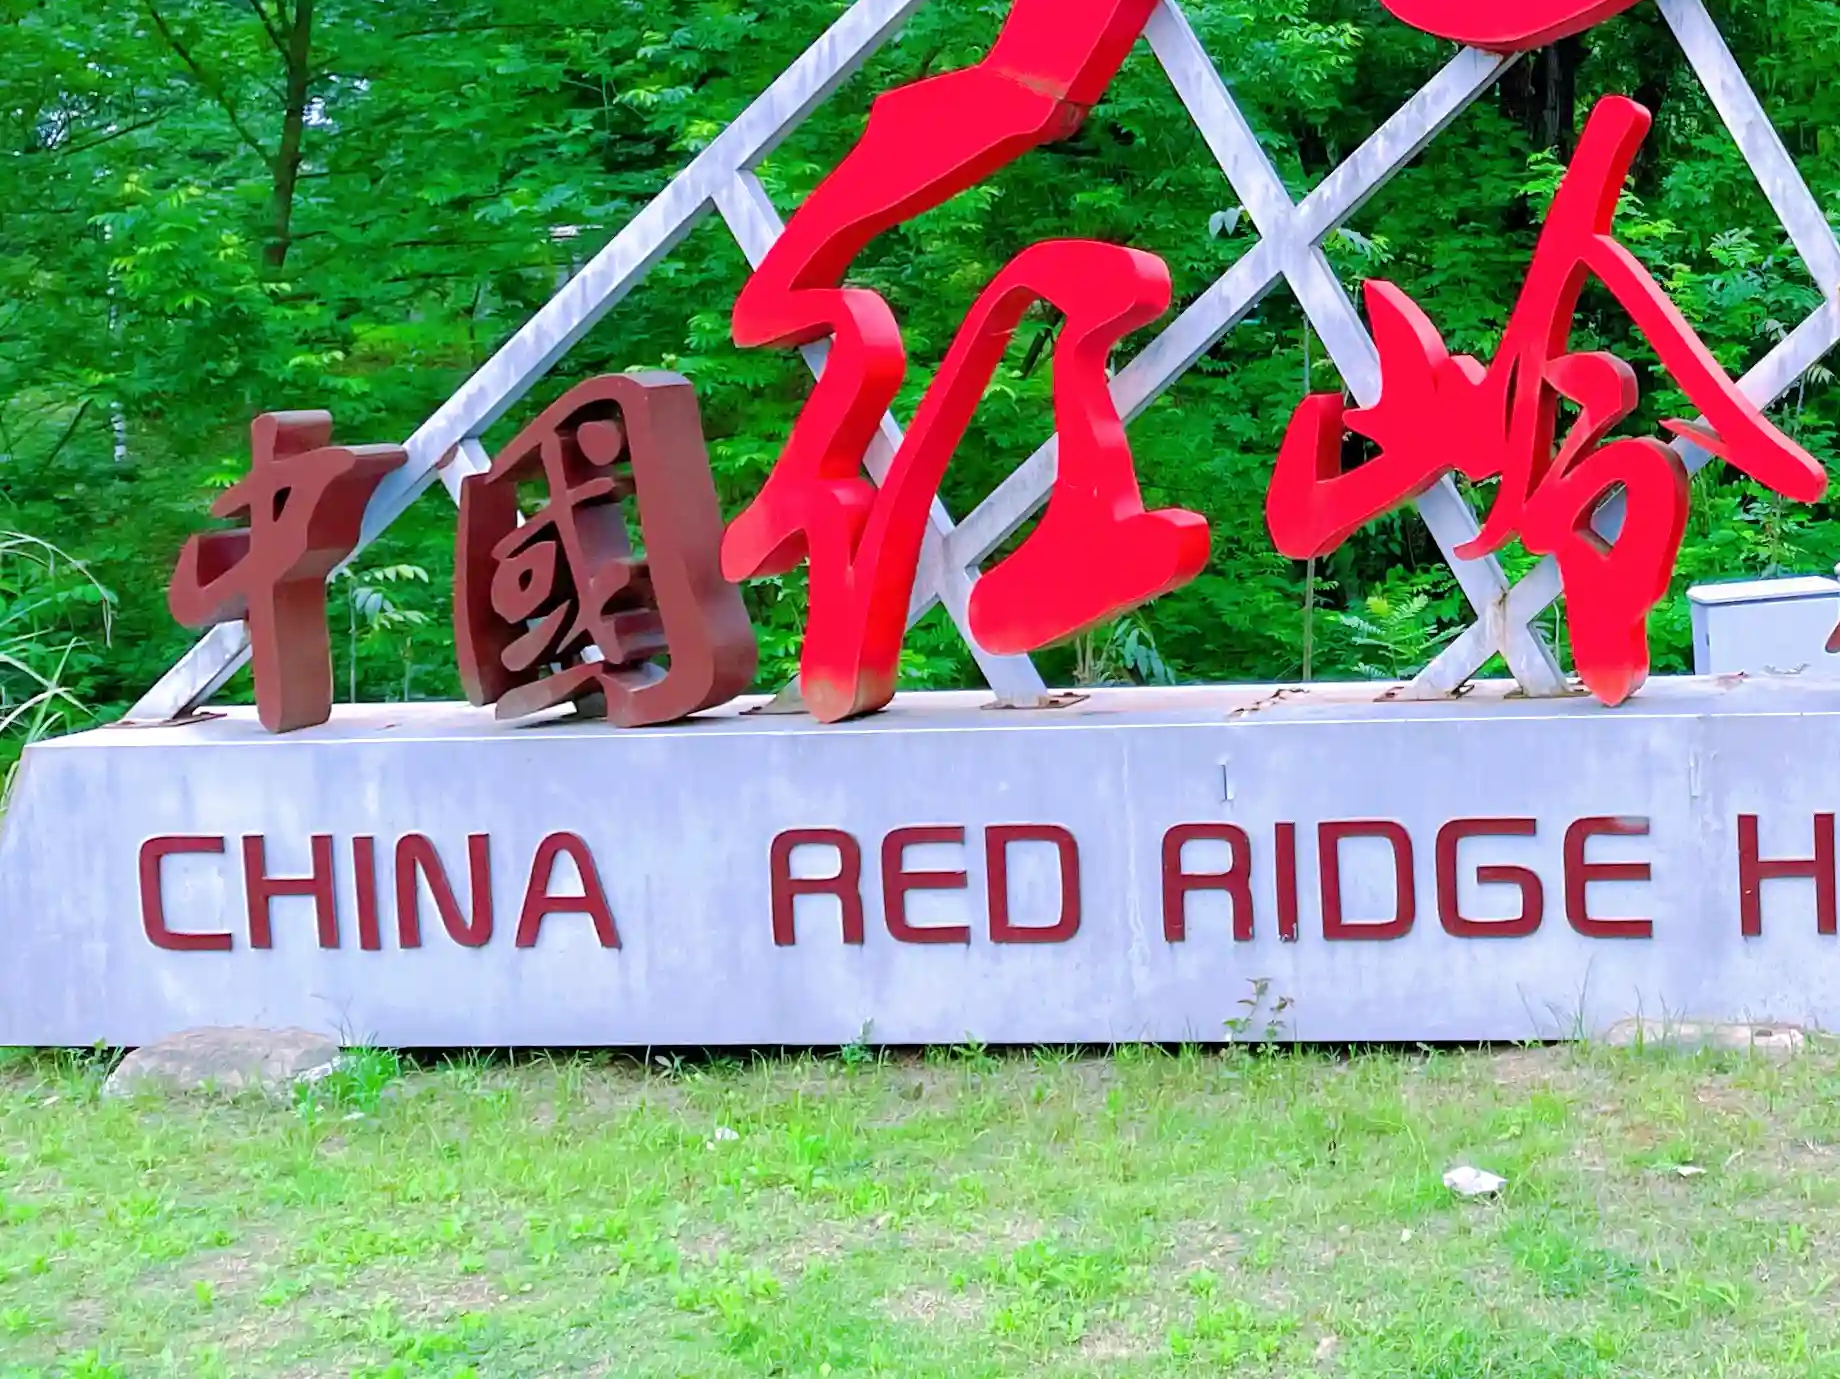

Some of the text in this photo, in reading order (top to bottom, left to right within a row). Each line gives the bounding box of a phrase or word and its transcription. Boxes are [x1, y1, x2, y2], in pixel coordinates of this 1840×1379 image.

[138, 831, 622, 952] CHINA
[769, 823, 1081, 947] RED
[1160, 816, 1654, 942] RIDGE
